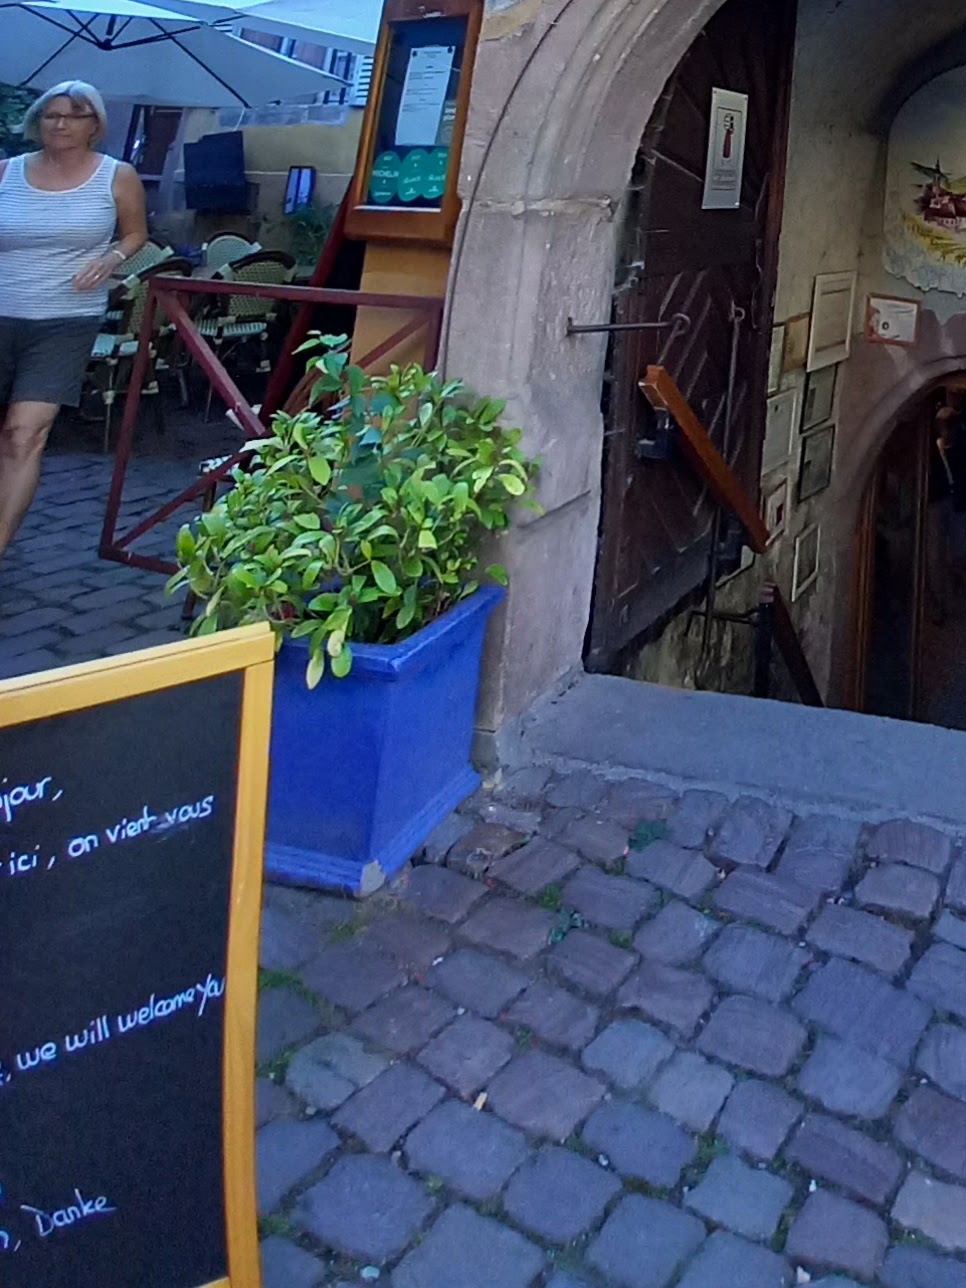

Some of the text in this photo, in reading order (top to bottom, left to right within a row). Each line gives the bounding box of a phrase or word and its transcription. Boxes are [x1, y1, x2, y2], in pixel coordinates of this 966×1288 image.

[68, 833, 98, 857] on
[105, 805, 157, 844] vient
[165, 795, 214, 824] vous
[16, 1041, 57, 1070] we
[65, 1014, 110, 1051] will
[117, 993, 195, 1033] welcome
[20, 1187, 117, 1237] Danke
